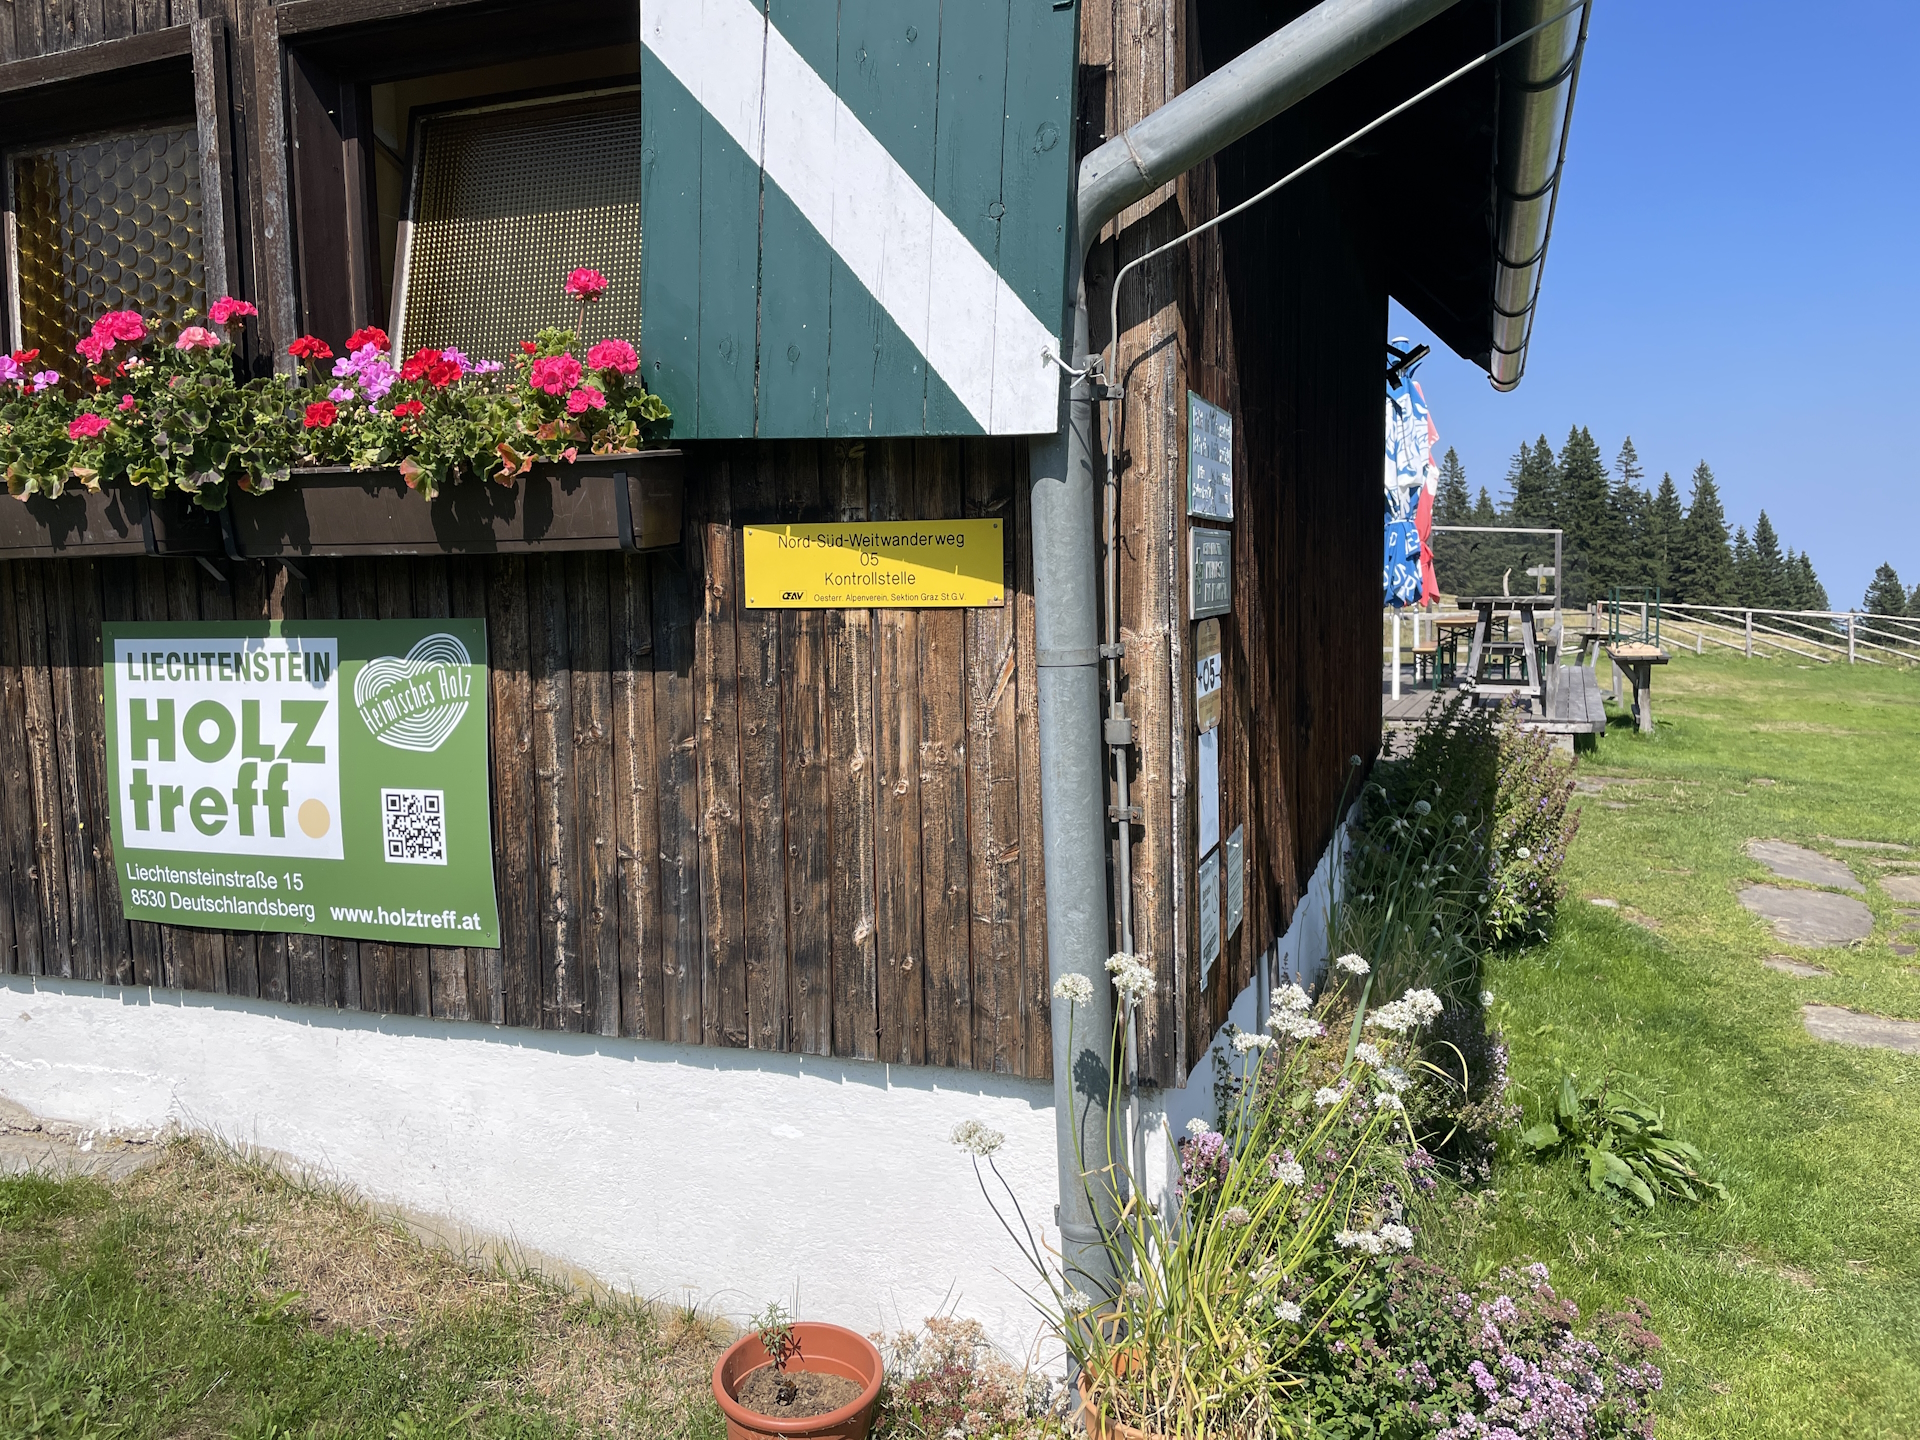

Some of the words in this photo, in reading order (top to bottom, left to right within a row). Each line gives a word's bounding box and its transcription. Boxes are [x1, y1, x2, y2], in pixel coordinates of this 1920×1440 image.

[778, 532, 965, 548] Nord-Süd-Weitwanderweg
[860, 552, 879, 567] 05
[824, 571, 916, 586] Kontrollstelle
[813, 593, 844, 602] Oesterr.
[891, 592, 919, 602] Sektion
[920, 592, 939, 601] Graz
[127, 651, 330, 682] LIECHTENSTEIN
[1202, 658, 1215, 692] 05
[359, 679, 435, 735] Heimisches
[438, 666, 471, 700] Holz
[129, 698, 329, 764] HOLZ
[126, 862, 278, 890] Liechtensteinstraße
[283, 872, 304, 891] 15
[130, 888, 166, 908] 8530
[170, 891, 316, 923] Deutschlandsberg
[329, 906, 482, 931] www.holztreff.at
